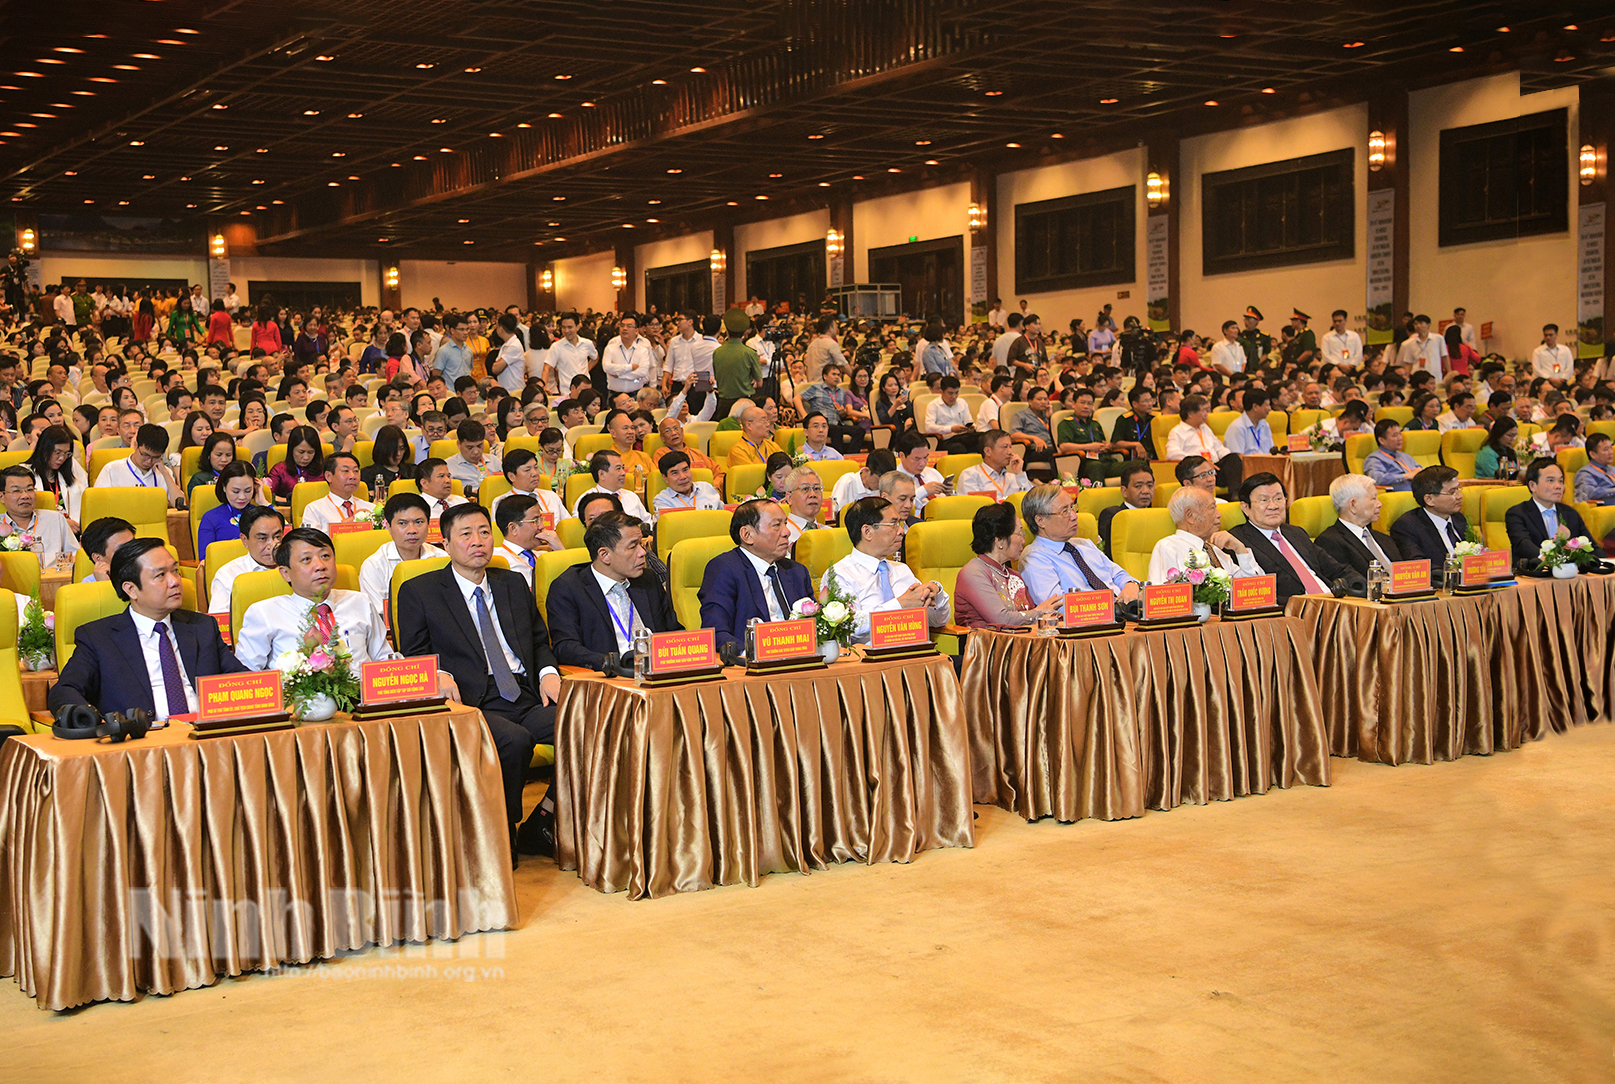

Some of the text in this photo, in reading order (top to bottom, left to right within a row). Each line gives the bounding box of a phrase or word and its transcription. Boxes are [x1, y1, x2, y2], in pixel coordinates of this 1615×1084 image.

[772, 635, 795, 646] THANH
[796, 634, 809, 643] MAI
[688, 644, 708, 655] QUANG
[400, 673, 418, 686] NGỌC
[208, 686, 273, 704] PHẠM QUANG NGỌC
